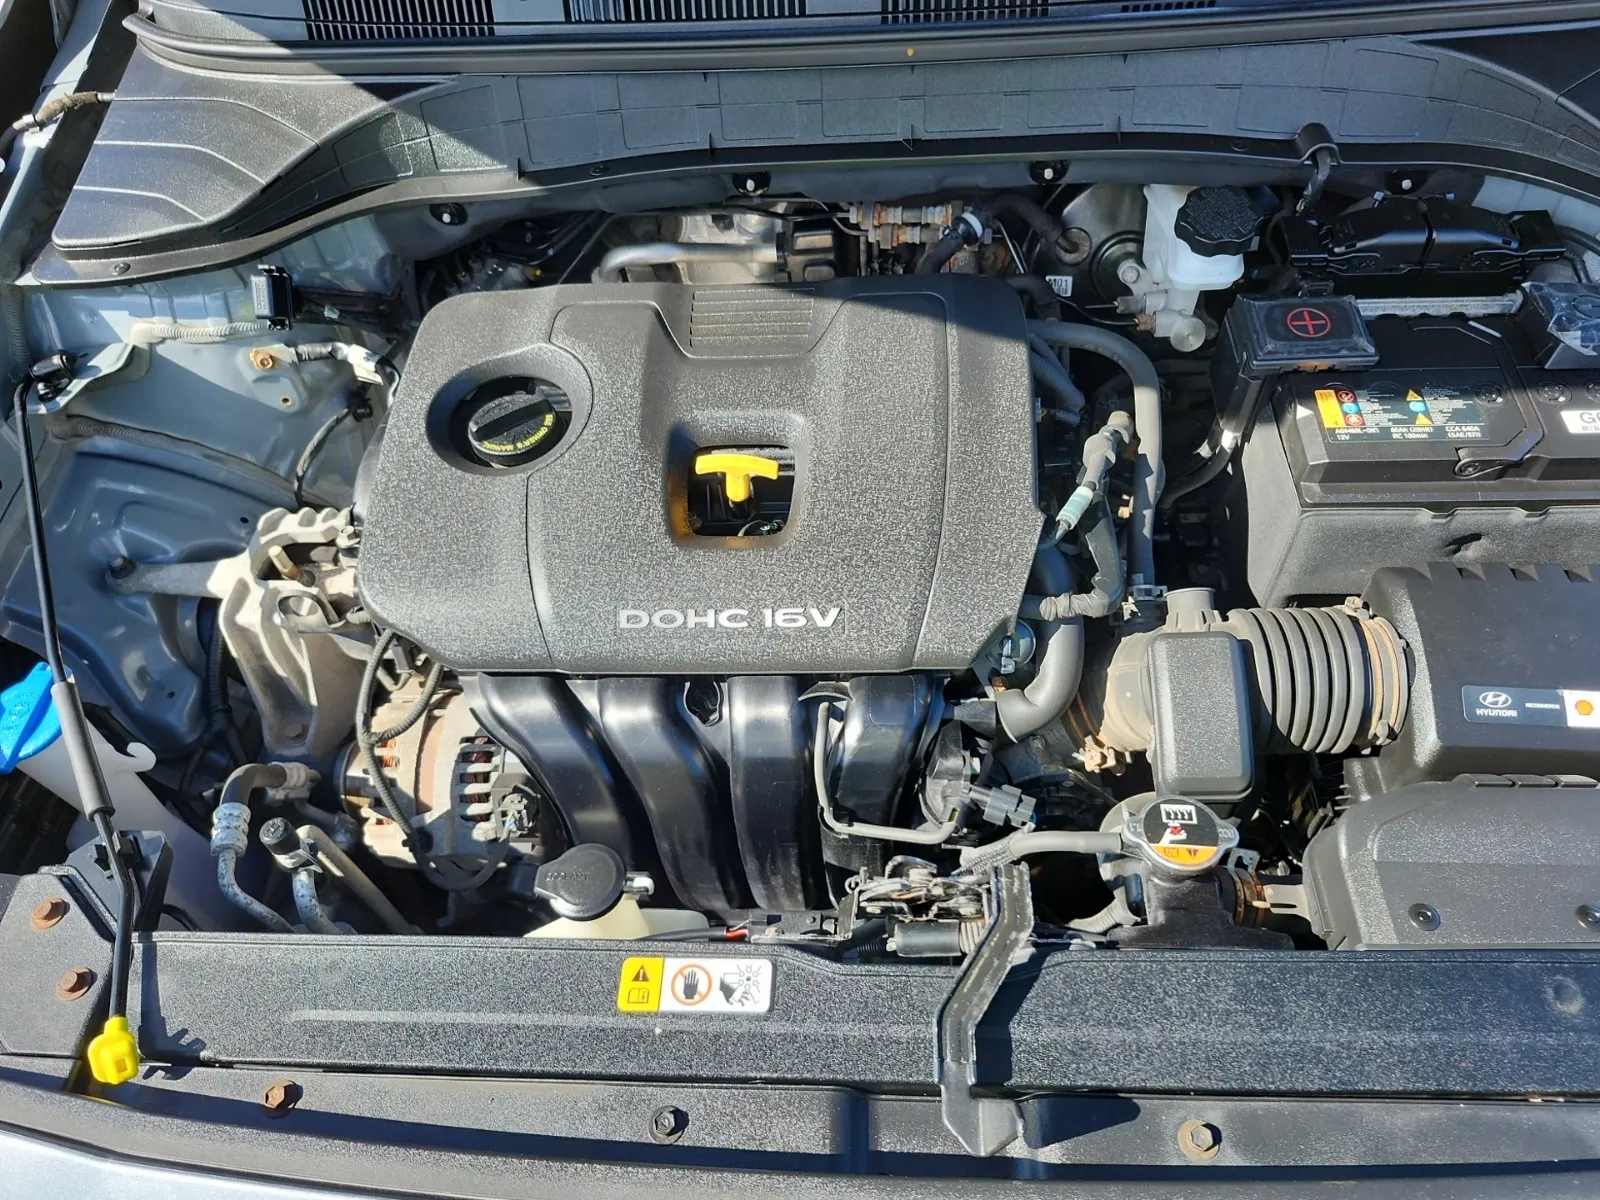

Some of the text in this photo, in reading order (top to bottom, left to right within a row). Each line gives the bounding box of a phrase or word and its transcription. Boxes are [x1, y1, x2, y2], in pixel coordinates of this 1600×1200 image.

[482, 440, 514, 452] MANUAL
[619, 607, 843, 629] DOHC 16V
[1475, 708, 1518, 718] HYUNDAI
[545, 871, 591, 882] COOLANT
